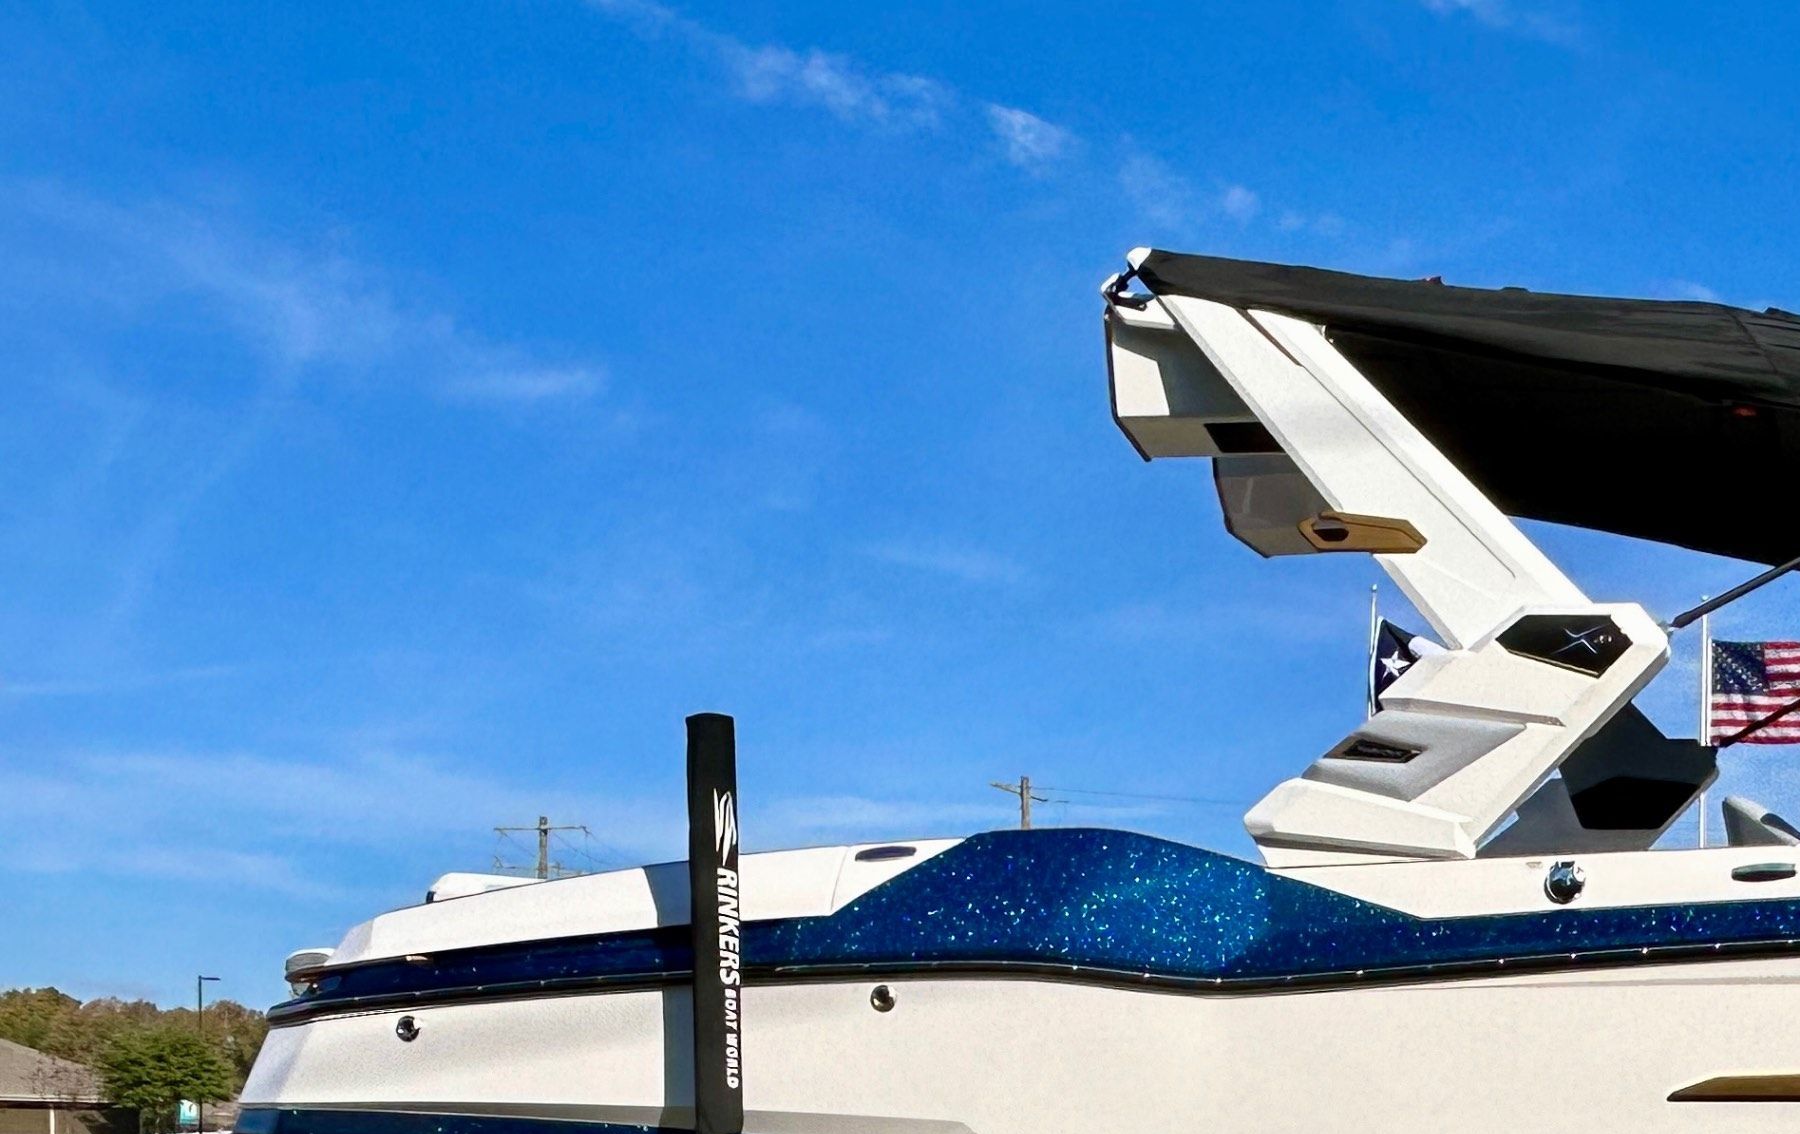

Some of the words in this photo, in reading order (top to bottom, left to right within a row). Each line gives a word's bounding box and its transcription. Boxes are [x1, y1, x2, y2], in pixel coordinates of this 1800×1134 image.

[716, 867, 740, 985] RINKERS
[724, 989, 738, 1030] BOAT
[725, 1034, 739, 1089] WORLD
